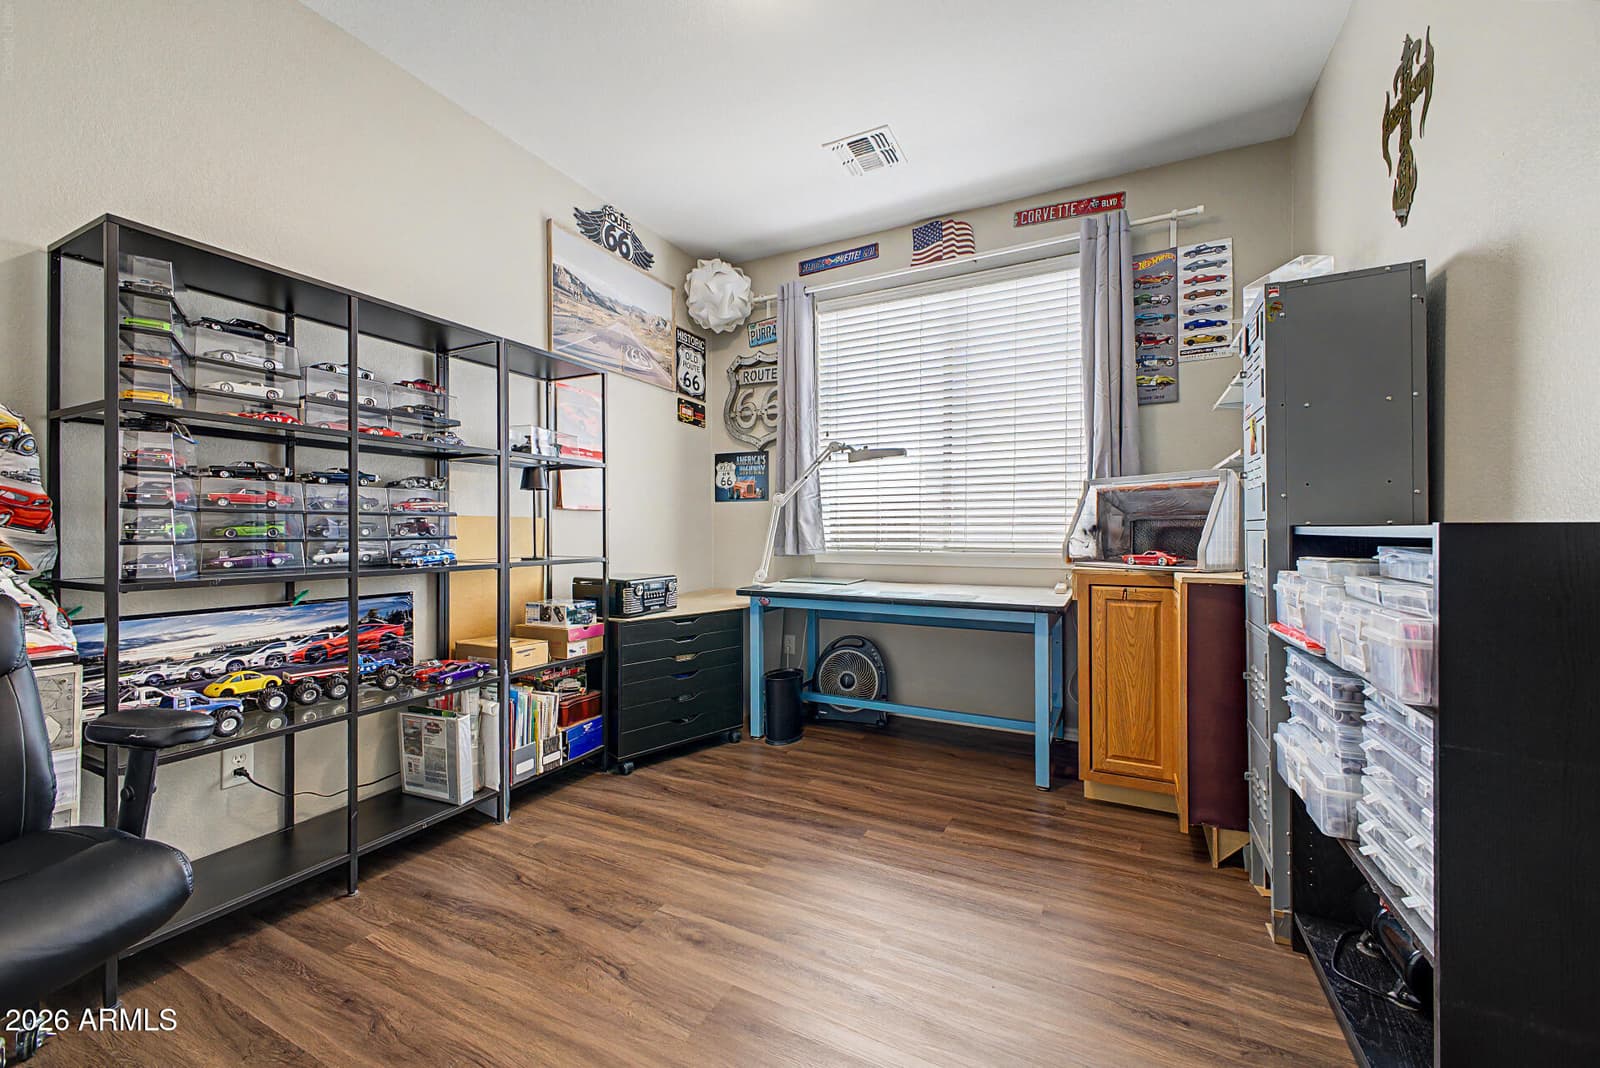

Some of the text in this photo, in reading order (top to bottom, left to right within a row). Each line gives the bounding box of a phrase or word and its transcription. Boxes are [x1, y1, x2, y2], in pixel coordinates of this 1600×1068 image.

[1021, 198, 1118, 225] CORVETTE BLVD
[604, 224, 632, 261] 66
[677, 329, 705, 349] HISTORIC
[685, 351, 698, 363] OLD
[683, 361, 701, 374] ROUTE
[743, 367, 777, 383] ROUTE
[684, 371, 700, 391] 66
[736, 387, 777, 430] 66
[736, 455, 766, 465] AMERICA'S
[721, 476, 733, 486] 66
